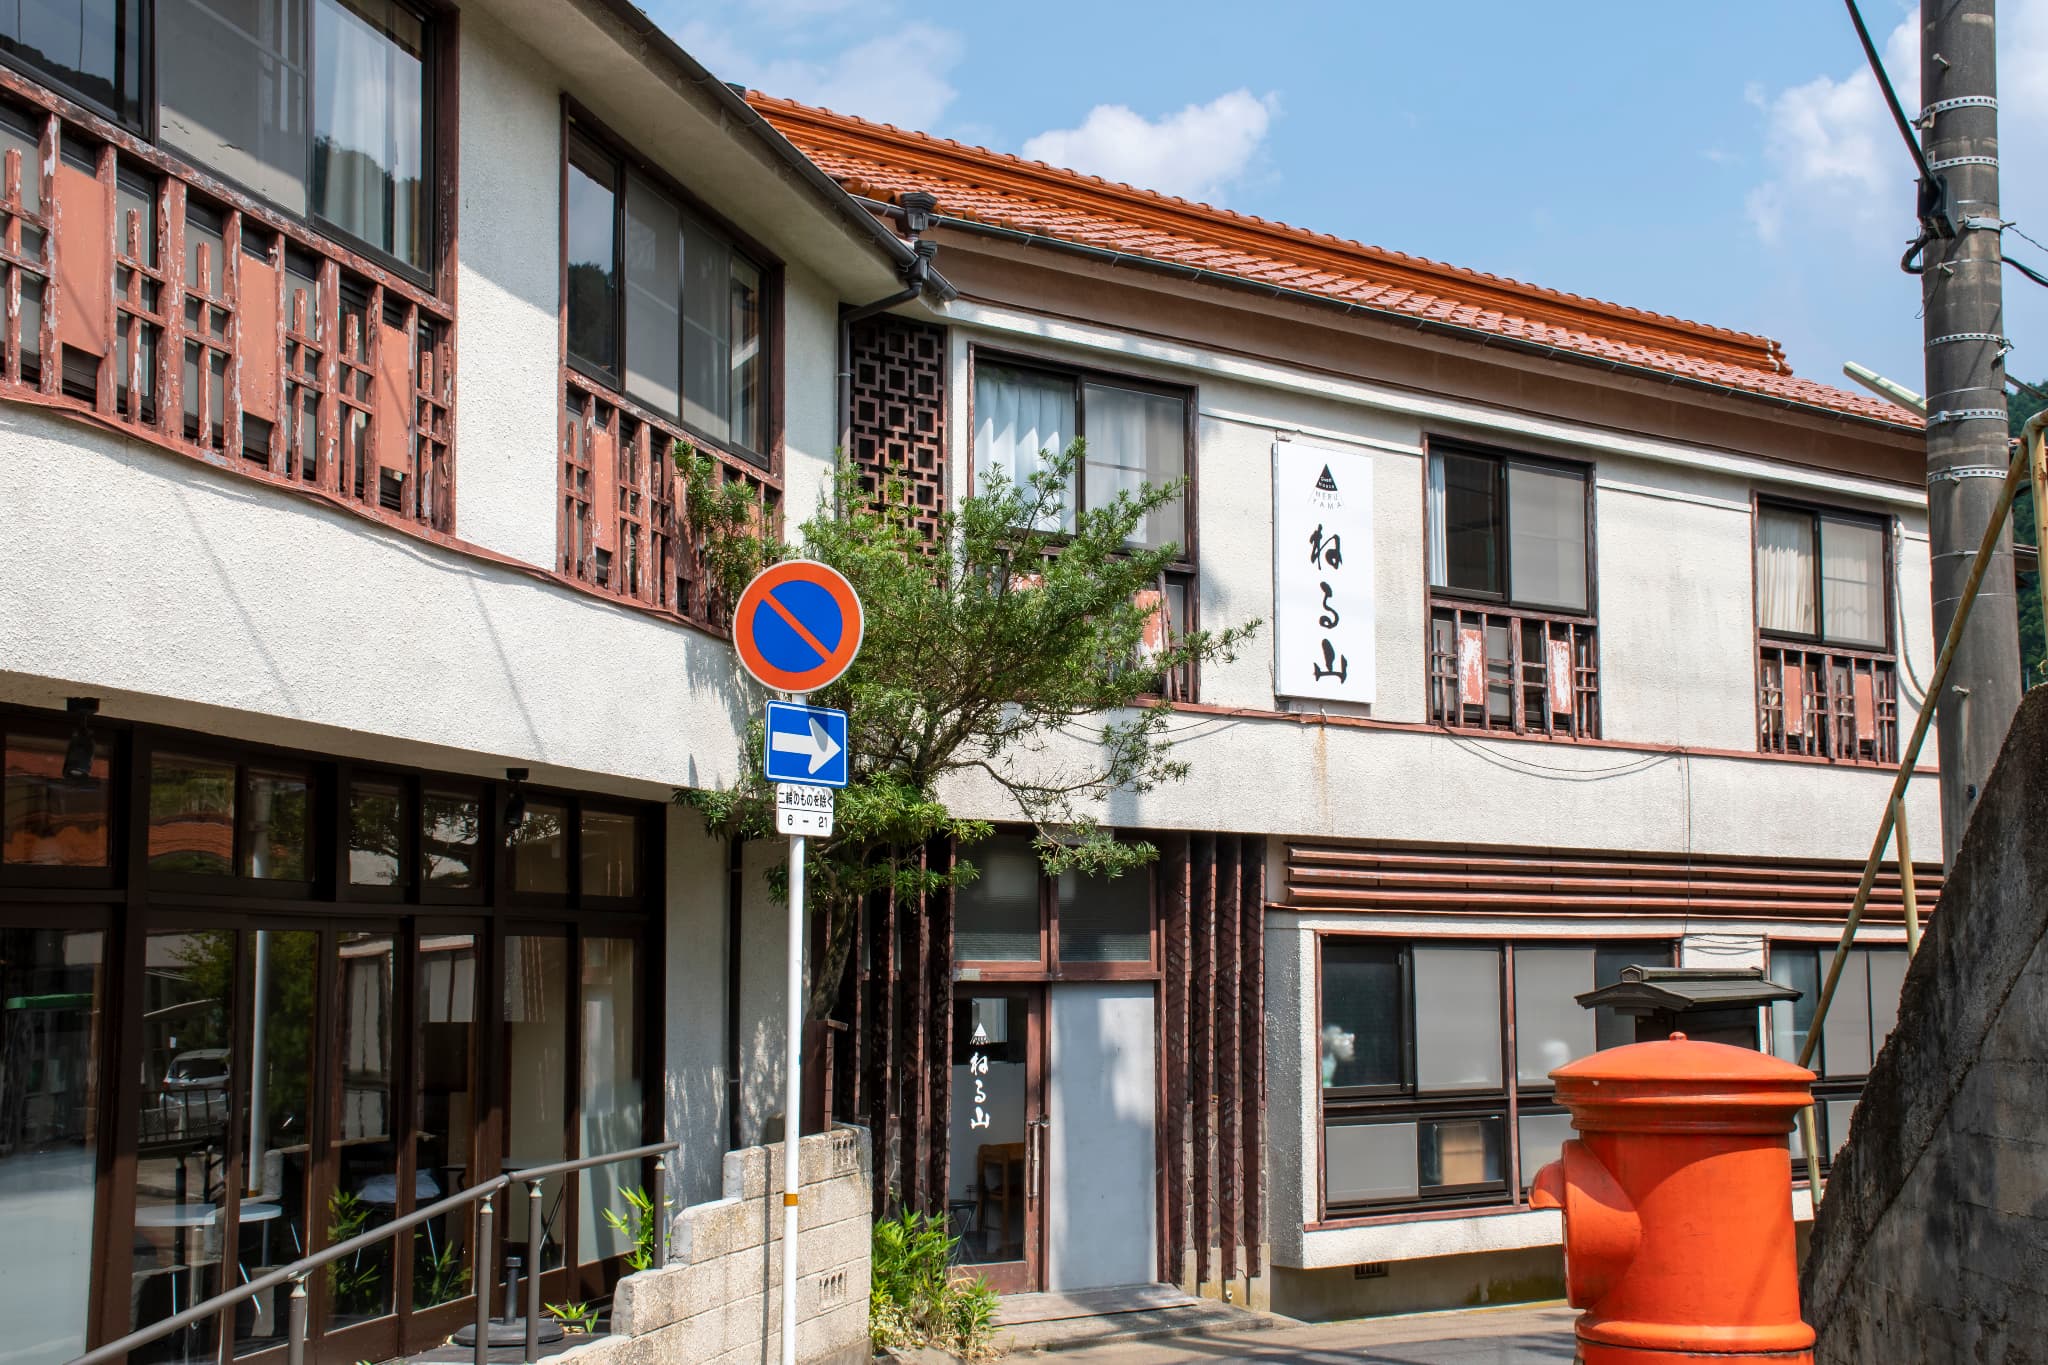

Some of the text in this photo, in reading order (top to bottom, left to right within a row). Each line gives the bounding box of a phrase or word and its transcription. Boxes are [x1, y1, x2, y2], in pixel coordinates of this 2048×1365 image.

[1309, 523, 1348, 684] ねる山
[778, 791, 833, 808] 二輪のものを除く
[970, 1051, 990, 1129] ねる山
